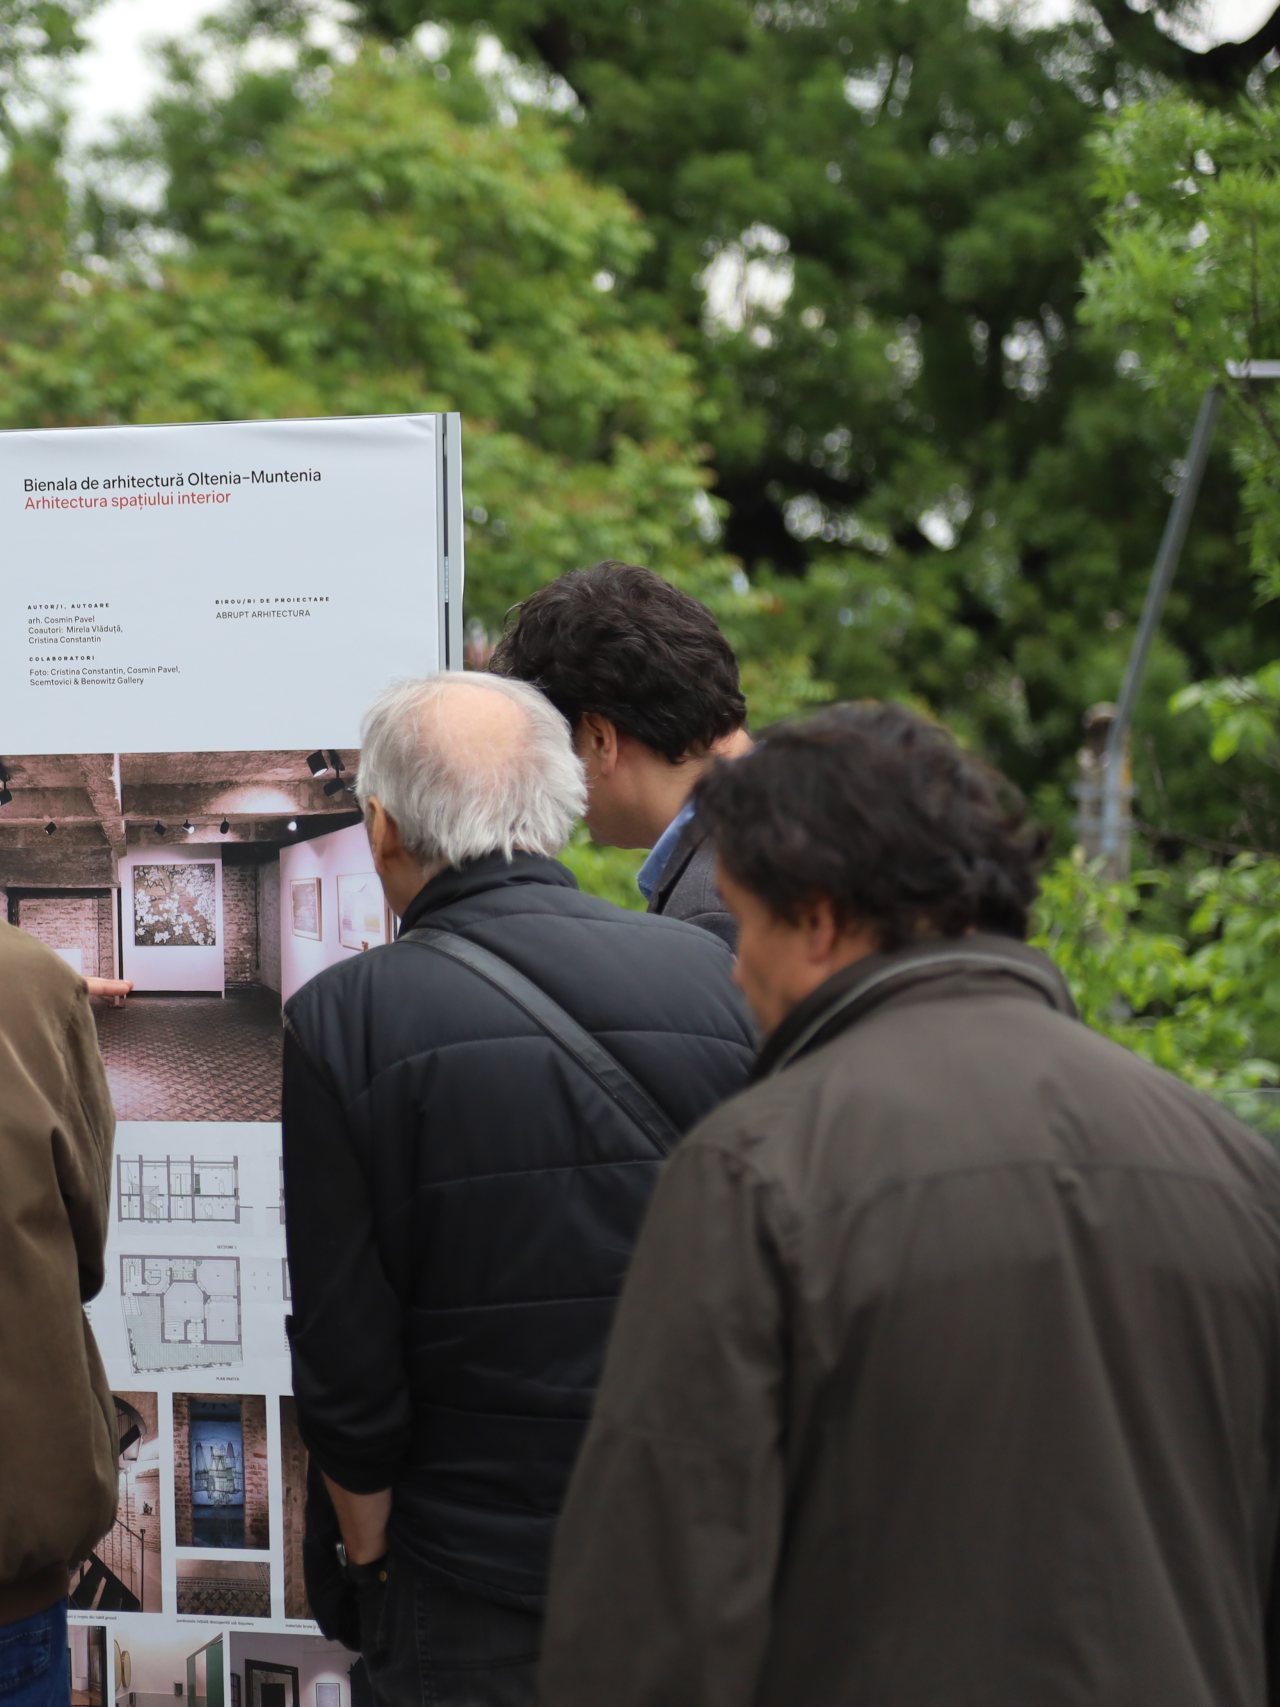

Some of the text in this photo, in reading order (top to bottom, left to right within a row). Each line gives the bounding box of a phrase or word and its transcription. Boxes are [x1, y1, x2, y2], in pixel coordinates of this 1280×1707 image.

[24, 477, 77, 492] Bienala
[80, 476, 99, 490] de
[103, 473, 184, 489] arhitectură
[25, 490, 231, 510] Arhitectura spațiului interior
[216, 610, 311, 619] ABRUPT ARHITECTURA
[28, 615, 95, 624] arh. Cosmin Pavel
[28, 626, 64, 634] Coautori:
[66, 625, 90, 633] Mirela
[28, 635, 102, 644] Cristina Constantin
[29, 665, 181, 676] Foto: Cristina Constantin, Cosmin Pavel,
[81, 677, 116, 685] Benowitz
[117, 676, 144, 685] Gallery
